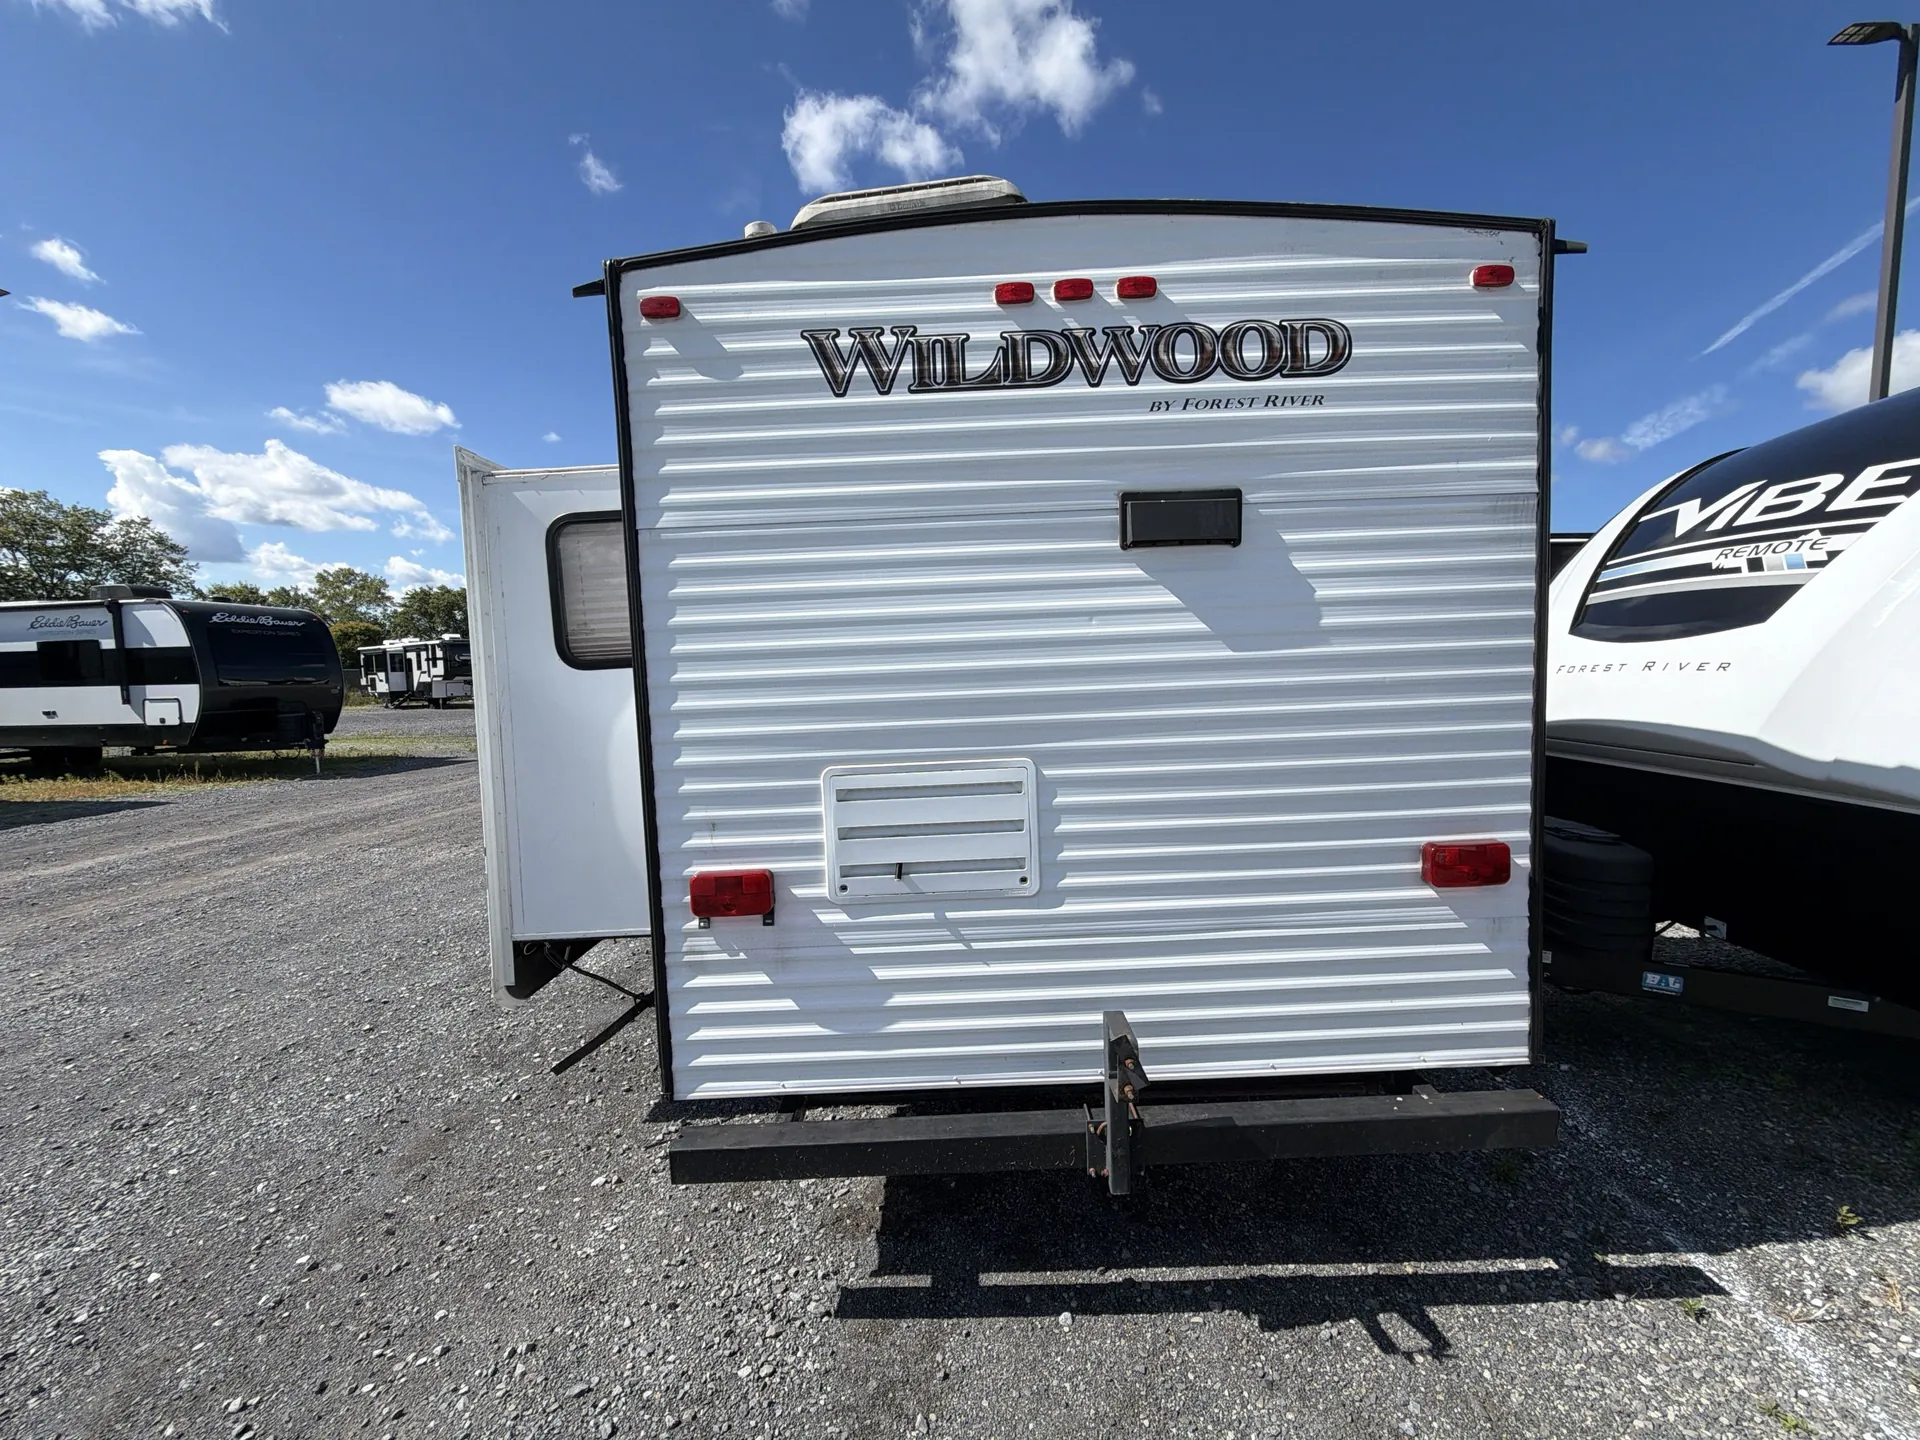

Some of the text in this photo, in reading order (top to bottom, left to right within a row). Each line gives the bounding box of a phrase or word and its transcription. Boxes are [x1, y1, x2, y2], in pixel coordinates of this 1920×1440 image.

[801, 318, 1352, 397] WILDWOOD
[1150, 394, 1325, 412] BY FOREST RIVER
[1638, 457, 1920, 538] VIBE
[1715, 537, 1831, 560] REMOTE
[26, 614, 108, 631] Eddie Bauer
[209, 612, 306, 626] Eddie Bauer
[1556, 661, 1731, 674] FOREST RIVER
